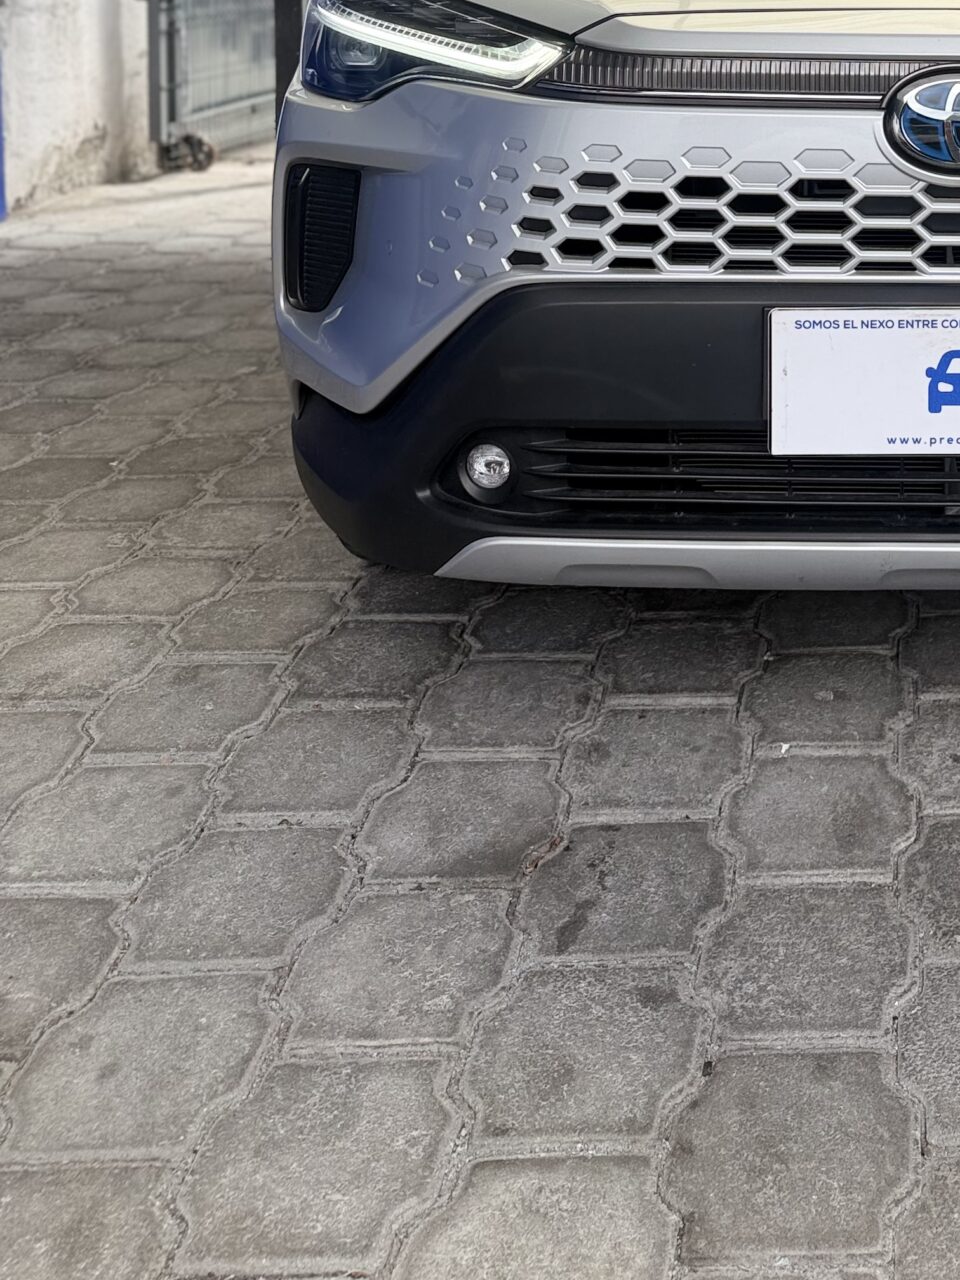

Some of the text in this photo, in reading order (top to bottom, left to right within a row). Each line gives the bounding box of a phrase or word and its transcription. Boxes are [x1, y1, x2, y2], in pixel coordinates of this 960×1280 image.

[794, 319, 840, 330] SOMOS
[843, 319, 858, 329] EL
[860, 319, 895, 329] NEXO
[897, 319, 938, 329] ENTRE
